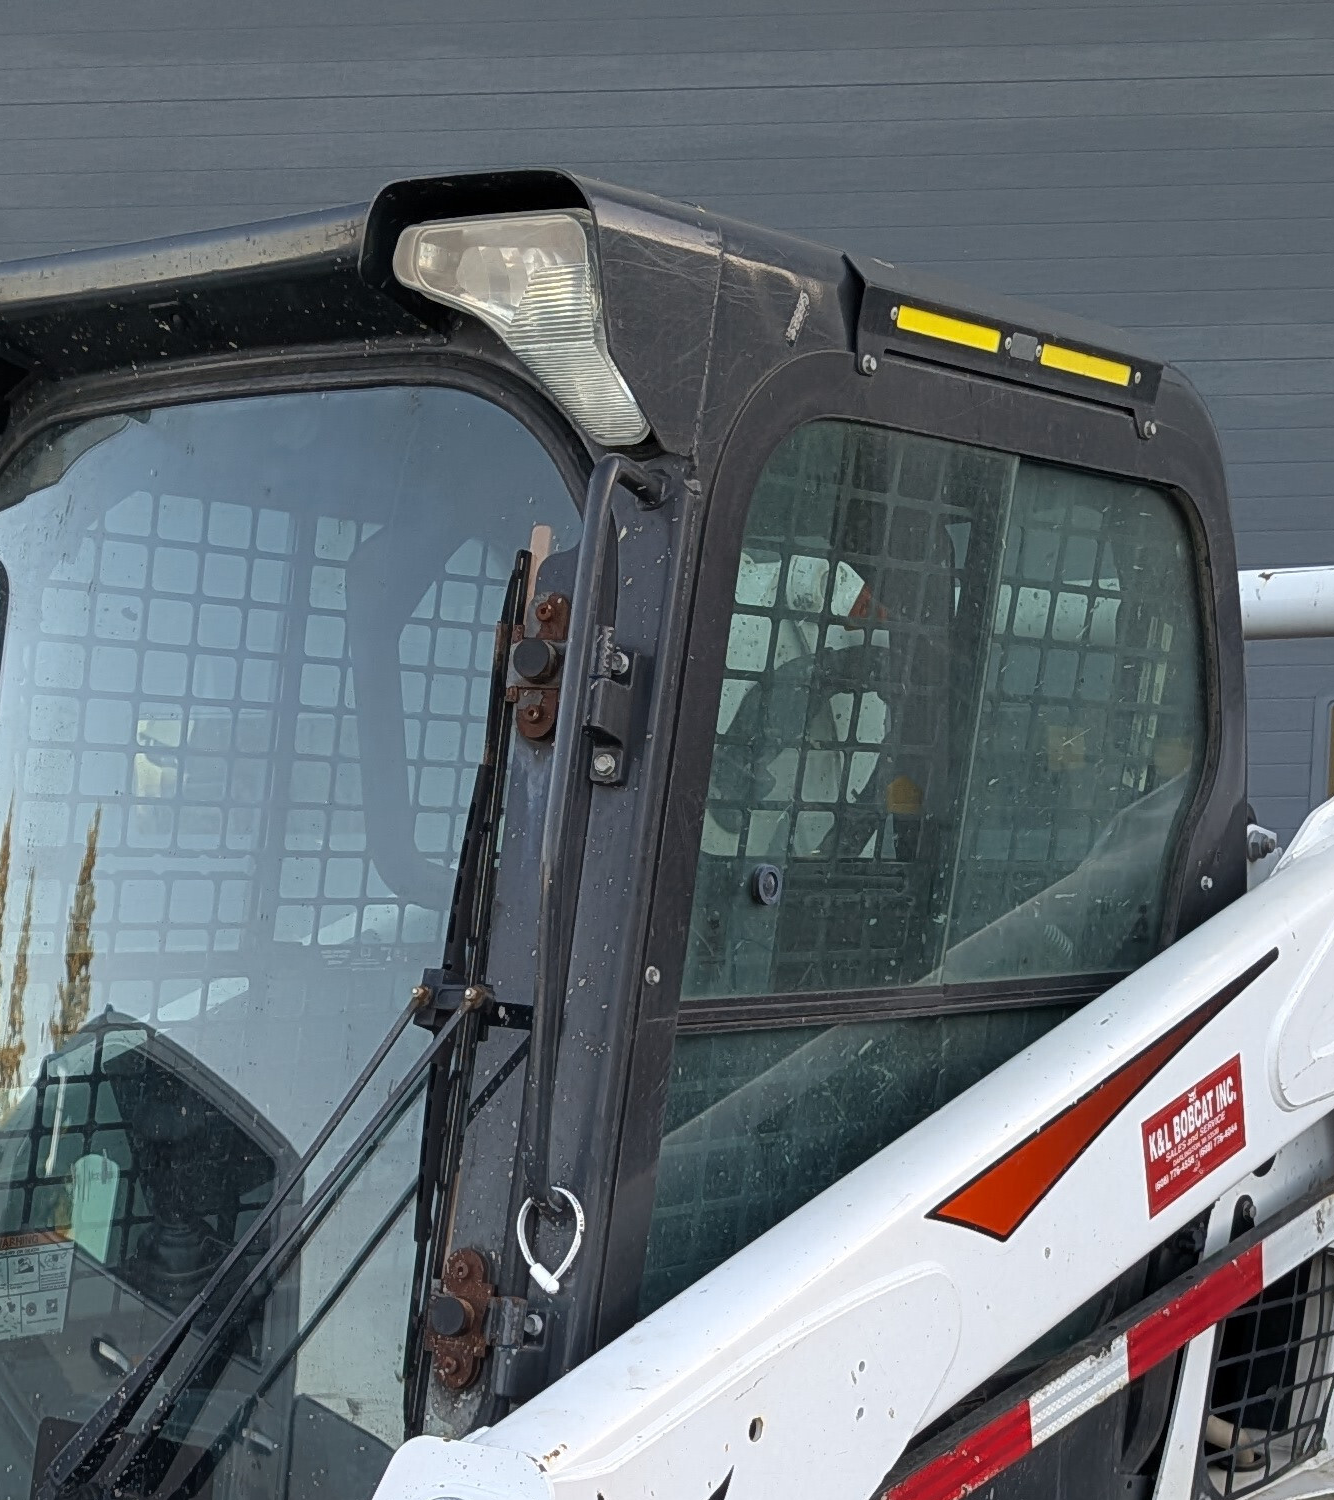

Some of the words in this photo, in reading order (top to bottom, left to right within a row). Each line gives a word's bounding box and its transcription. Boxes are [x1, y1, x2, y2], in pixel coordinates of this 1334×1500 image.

[1148, 1122, 1172, 1163] K&L
[1173, 1089, 1214, 1144] BOBCAT
[1215, 1076, 1237, 1113] INC.
[1165, 1140, 1187, 1163] SALES
[1187, 1131, 1199, 1146] and
[1200, 1110, 1226, 1136] SERVICE
